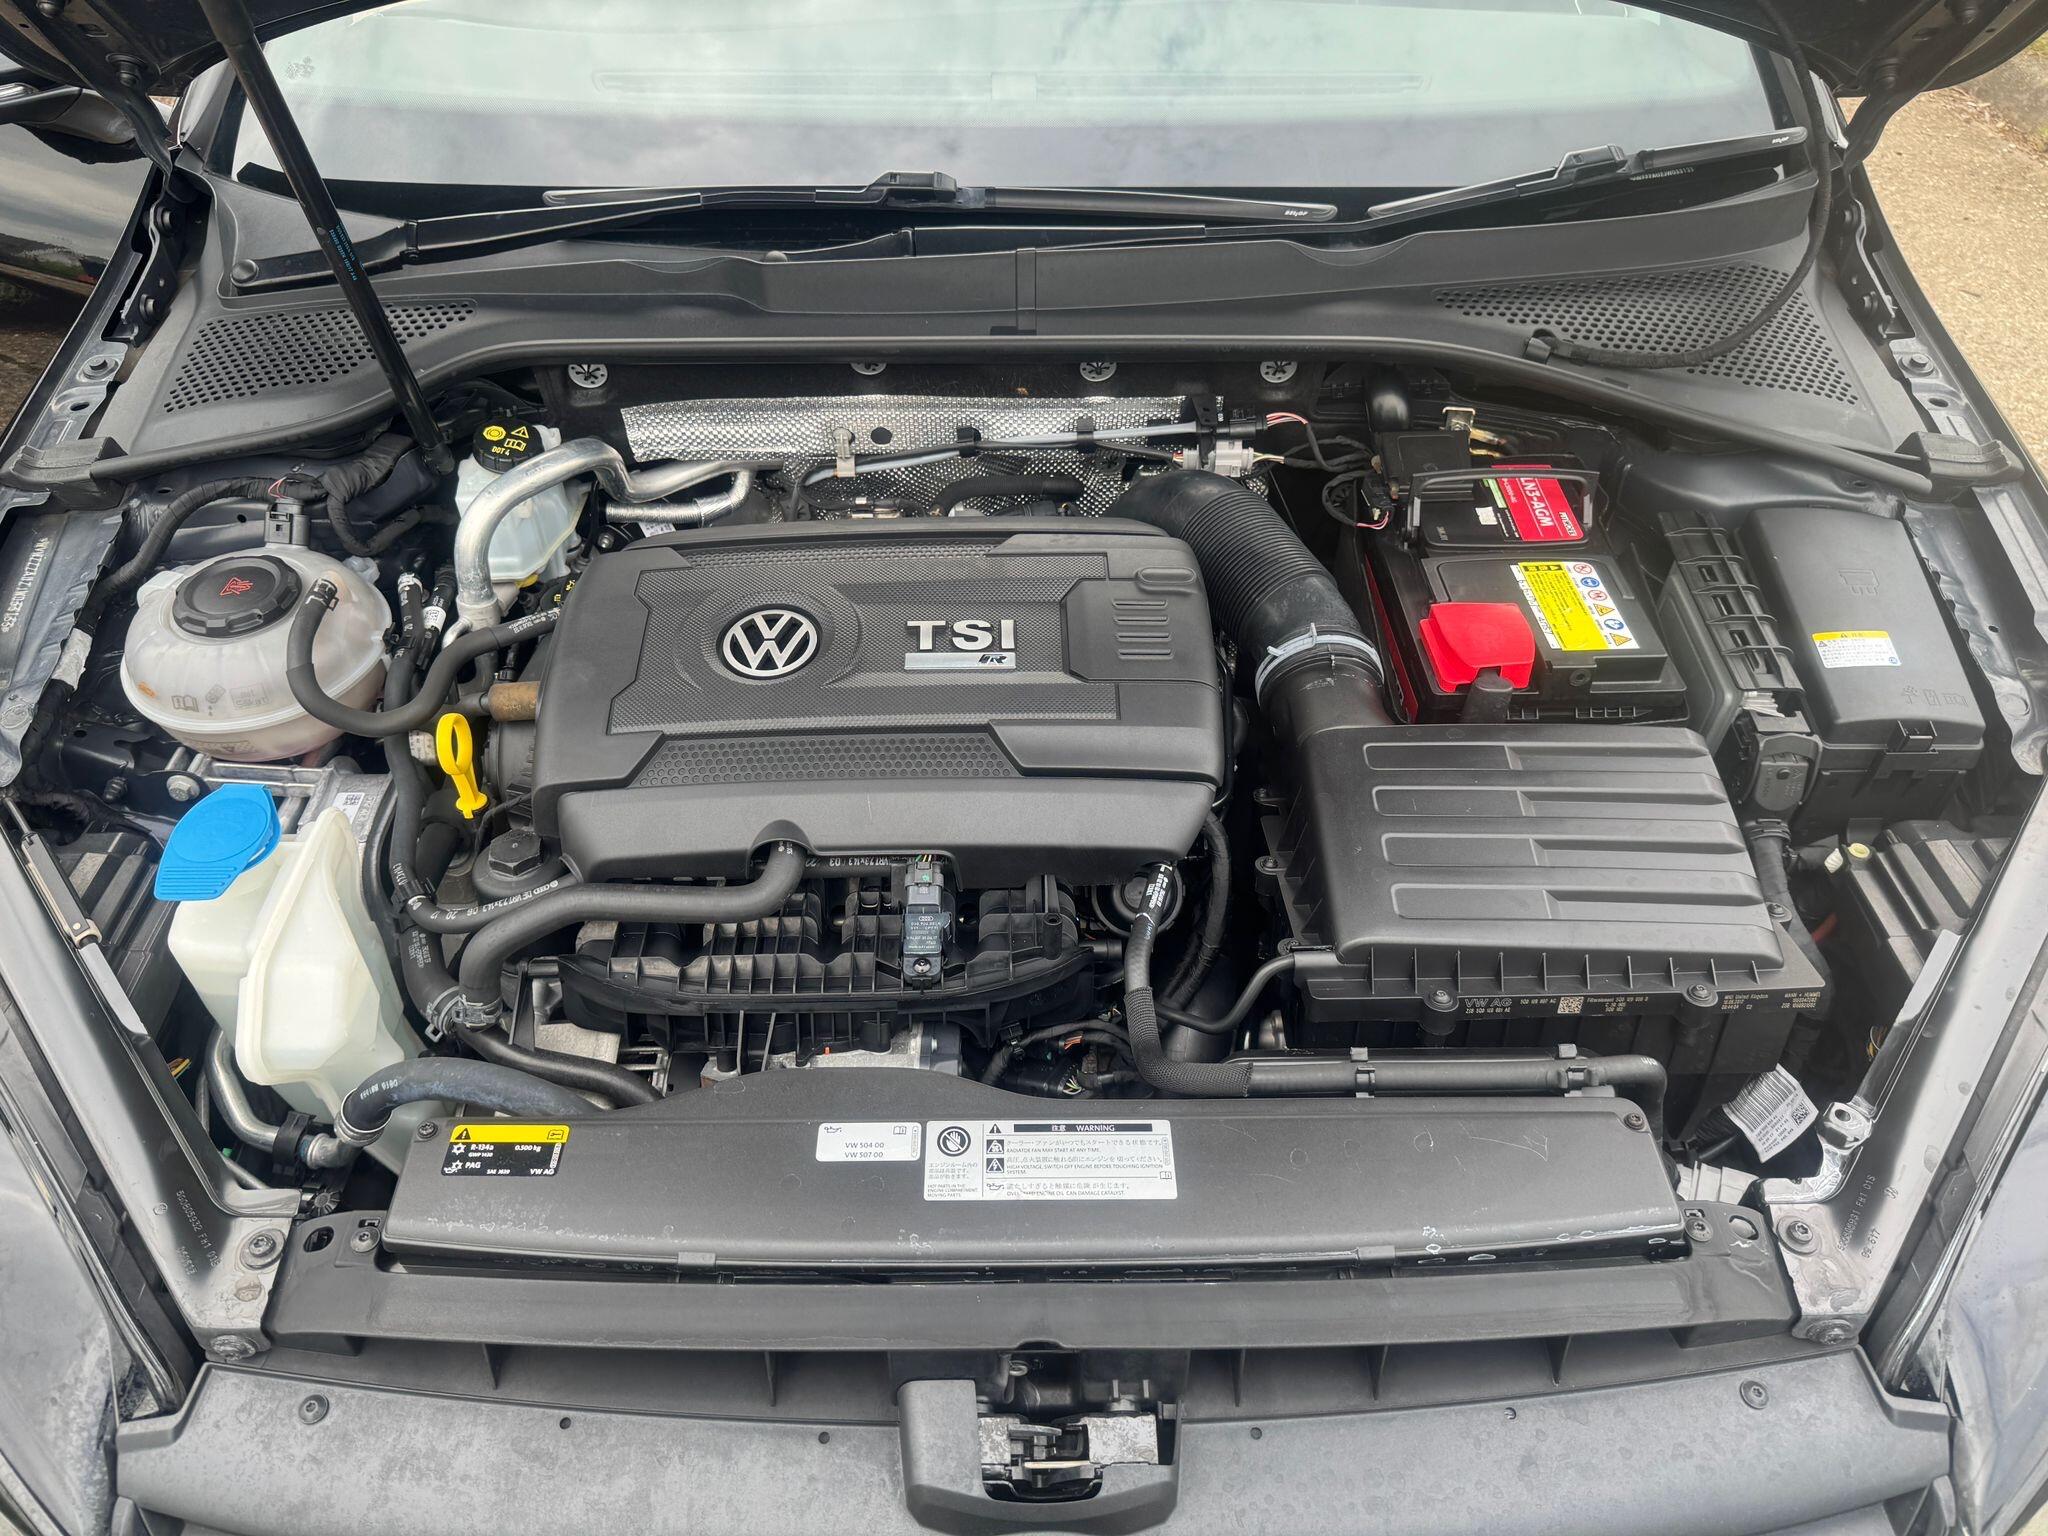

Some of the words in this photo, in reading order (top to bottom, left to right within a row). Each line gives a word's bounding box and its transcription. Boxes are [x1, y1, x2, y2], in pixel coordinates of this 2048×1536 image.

[491, 446, 505, 454] DOT
[1520, 478, 1555, 527] LN3-AGM
[907, 619, 1016, 650] TSI
[1464, 998, 1489, 1008] VW
[1490, 997, 1513, 1007] AG
[1076, 1124, 1115, 1132] WARNING
[470, 1143, 495, 1151] R-134a
[532, 1144, 541, 1153] kg
[464, 1161, 482, 1169] PAG
